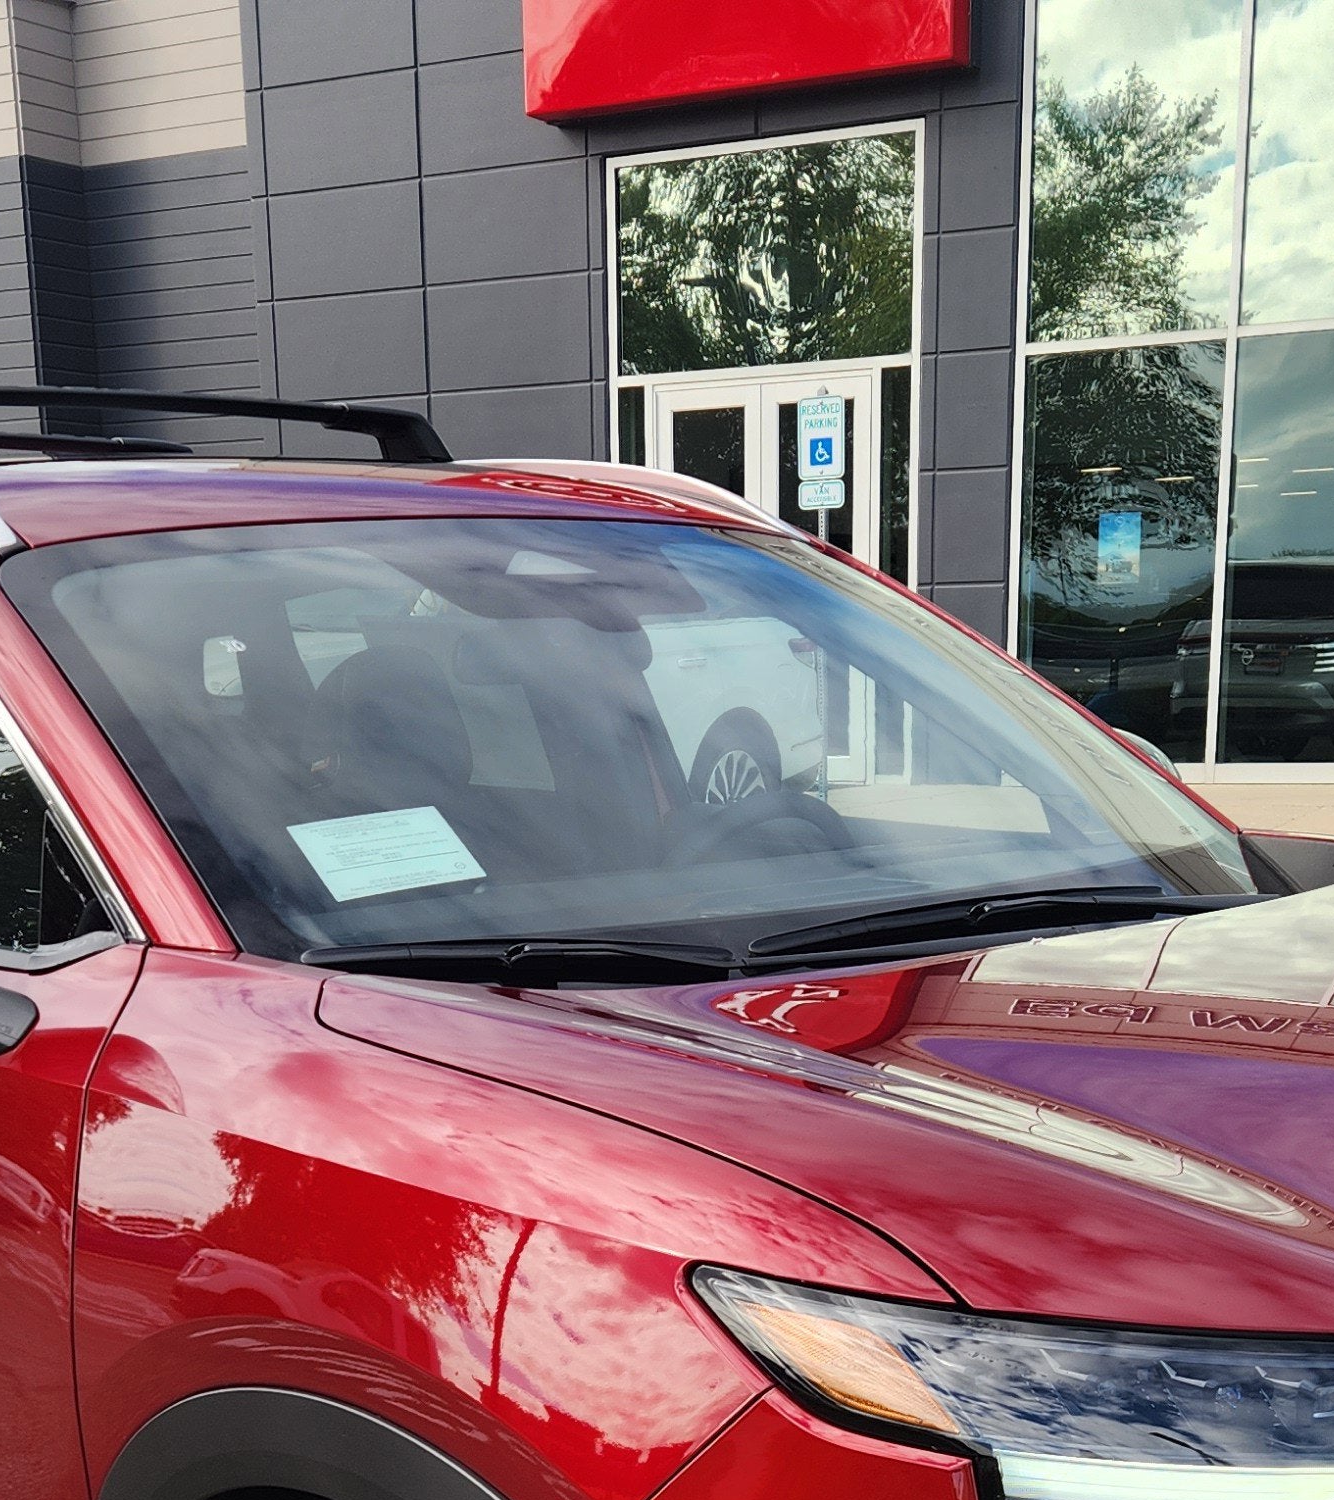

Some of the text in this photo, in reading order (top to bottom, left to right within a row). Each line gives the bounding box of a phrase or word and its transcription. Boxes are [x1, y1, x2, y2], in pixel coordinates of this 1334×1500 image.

[801, 403, 840, 415] RESERVED
[804, 417, 838, 429] PARKING
[814, 487, 830, 496] VAN
